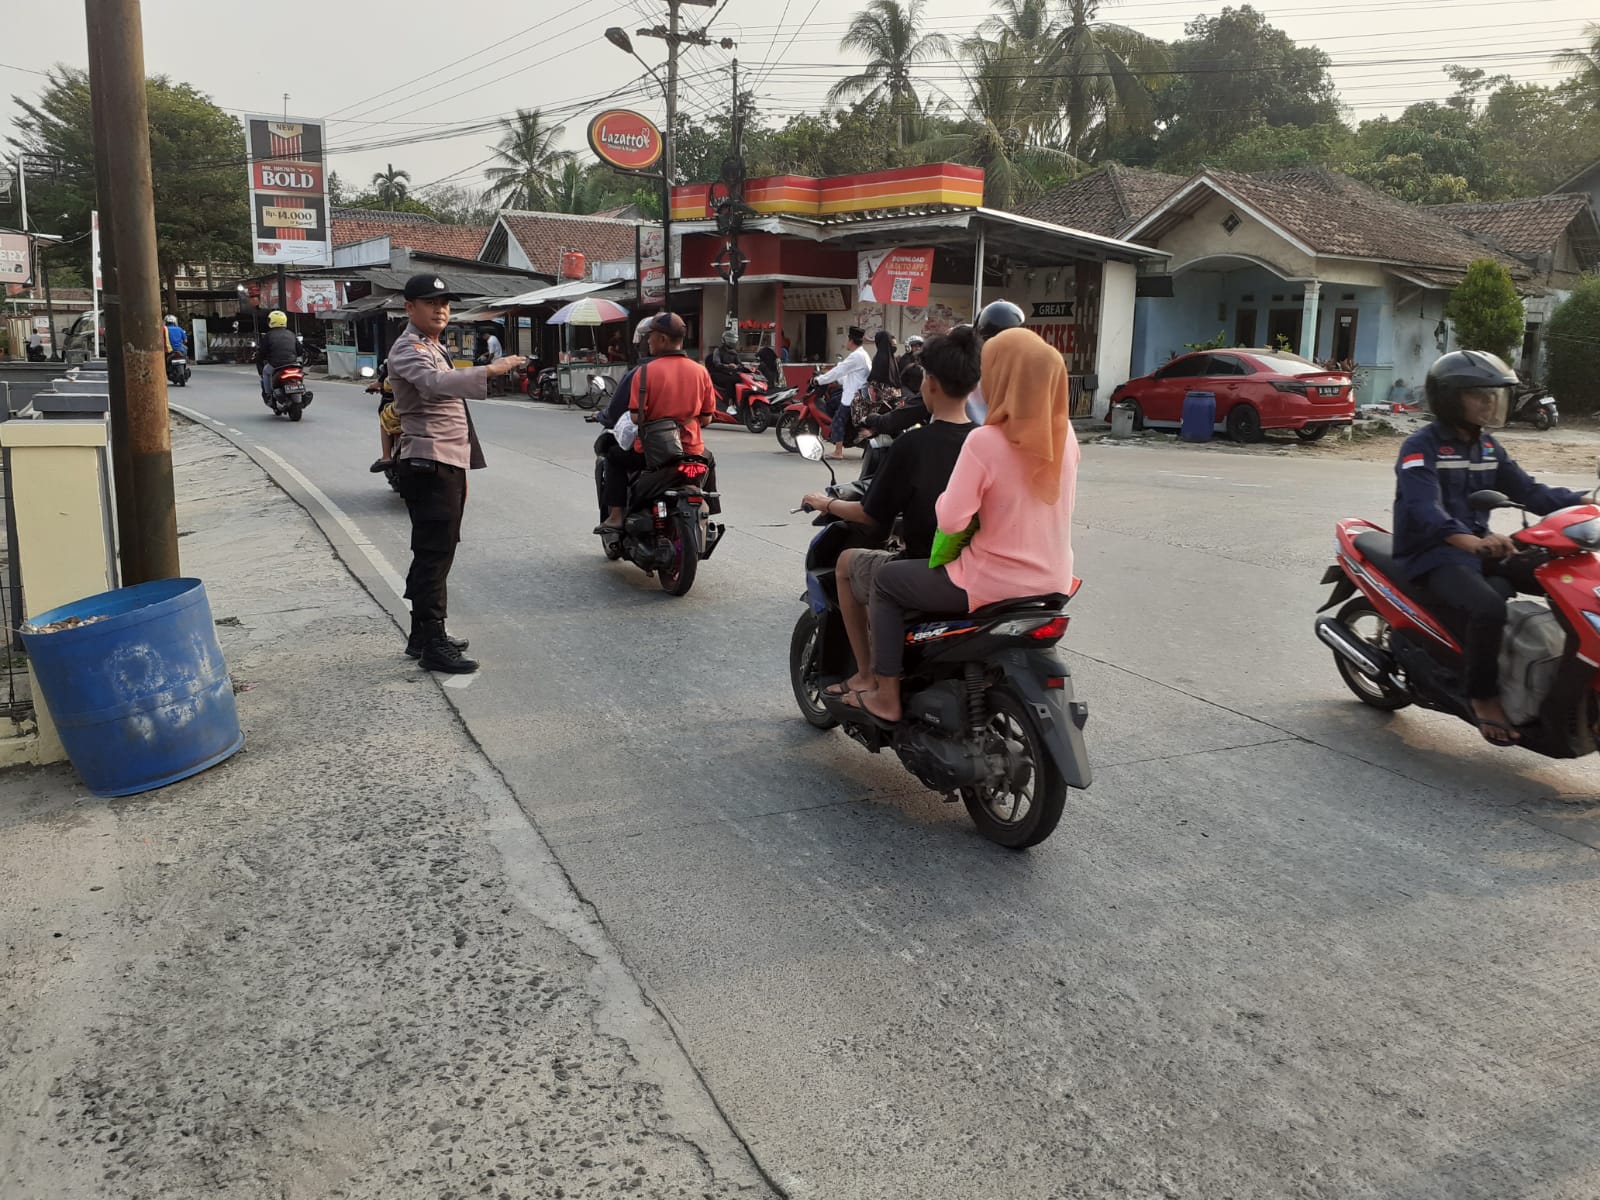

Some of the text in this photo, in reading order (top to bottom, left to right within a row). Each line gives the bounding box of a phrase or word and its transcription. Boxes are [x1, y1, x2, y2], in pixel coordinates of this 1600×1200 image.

[276, 123, 294, 131] NEW
[601, 125, 644, 148] Lazatto
[262, 170, 314, 188] BOLD
[278, 211, 312, 221] 14.000
[892, 255, 925, 263] DOWNLOAD
[1039, 304, 1065, 315] GREAT
